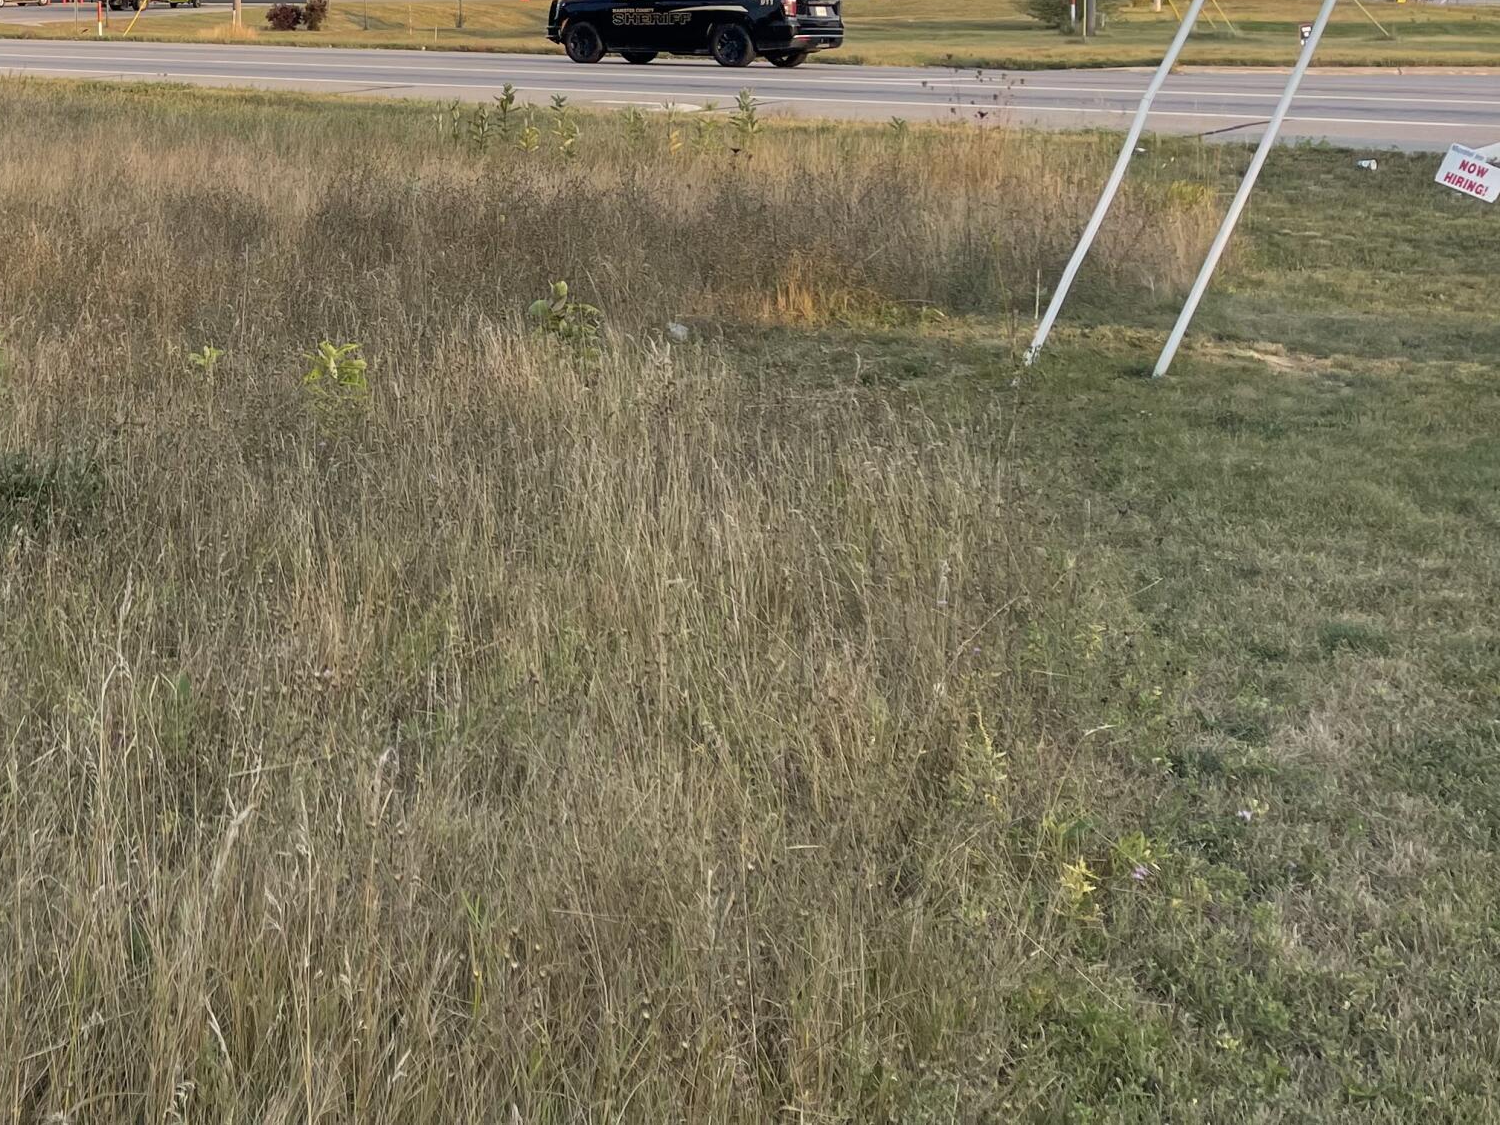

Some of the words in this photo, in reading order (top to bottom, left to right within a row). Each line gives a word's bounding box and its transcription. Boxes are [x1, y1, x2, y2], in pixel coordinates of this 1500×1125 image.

[612, 12, 692, 26] SHERIFF
[1458, 159, 1489, 179] NOW
[1443, 171, 1489, 197] HIRING!
